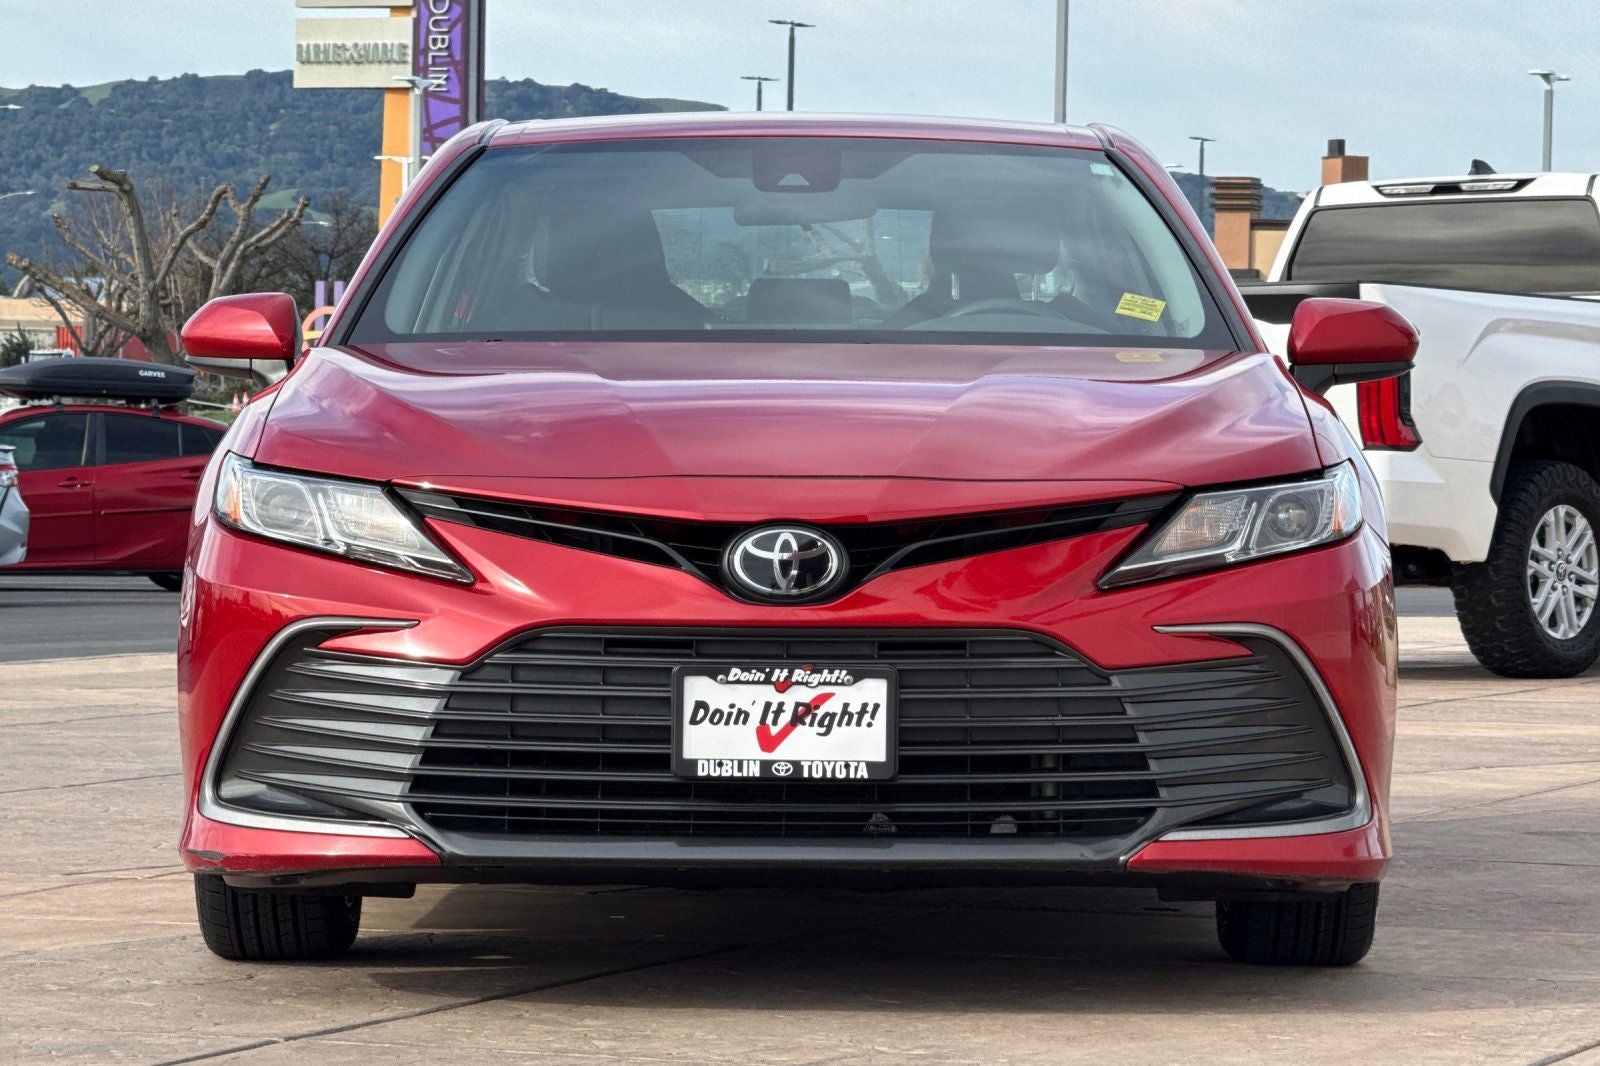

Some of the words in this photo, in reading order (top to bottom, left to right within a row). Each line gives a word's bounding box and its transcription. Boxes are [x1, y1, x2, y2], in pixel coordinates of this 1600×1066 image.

[428, 0, 450, 91] DUBLIN
[727, 667, 769, 682] Doin'
[771, 669, 790, 682] It
[791, 669, 847, 687] Right!
[688, 700, 756, 726] Doin'
[758, 701, 785, 726] It
[789, 701, 881, 737] Right!
[697, 759, 760, 777] DUBLIN
[801, 760, 869, 779] TOYOTA
